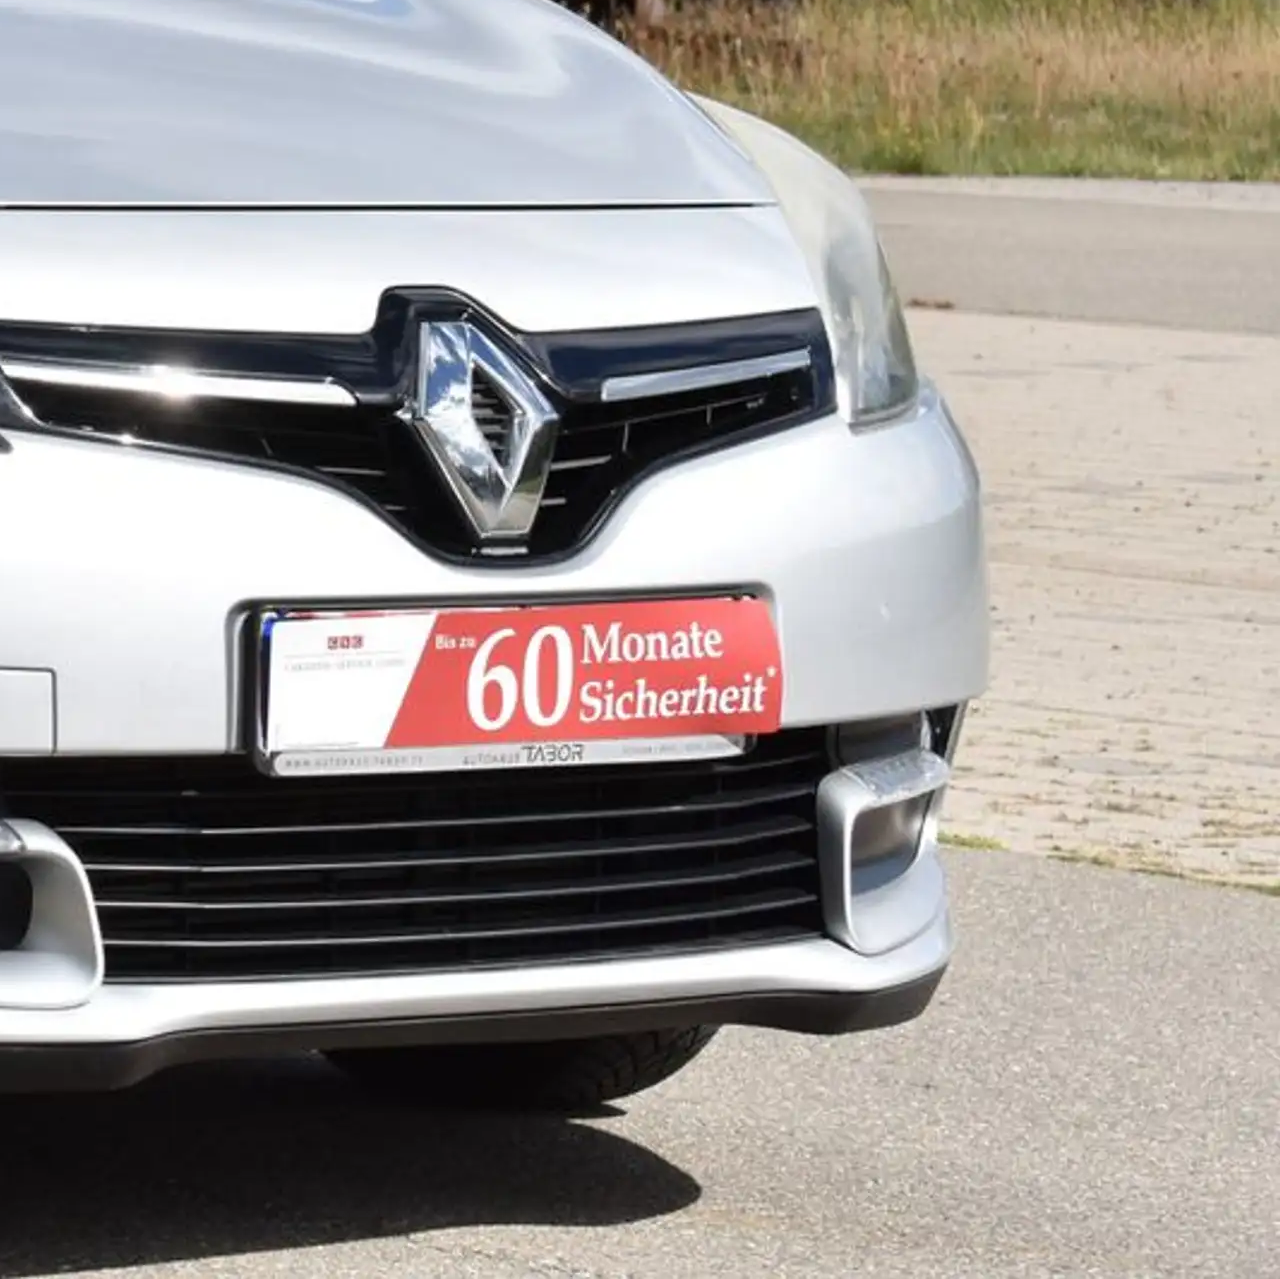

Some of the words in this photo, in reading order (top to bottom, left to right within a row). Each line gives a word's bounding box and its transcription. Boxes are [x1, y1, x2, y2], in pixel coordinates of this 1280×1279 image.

[435, 635, 456, 650] Bis
[459, 636, 476, 649] zu
[580, 621, 723, 664] Monate
[466, 625, 574, 732] 60
[521, 744, 584, 762] TABOR
